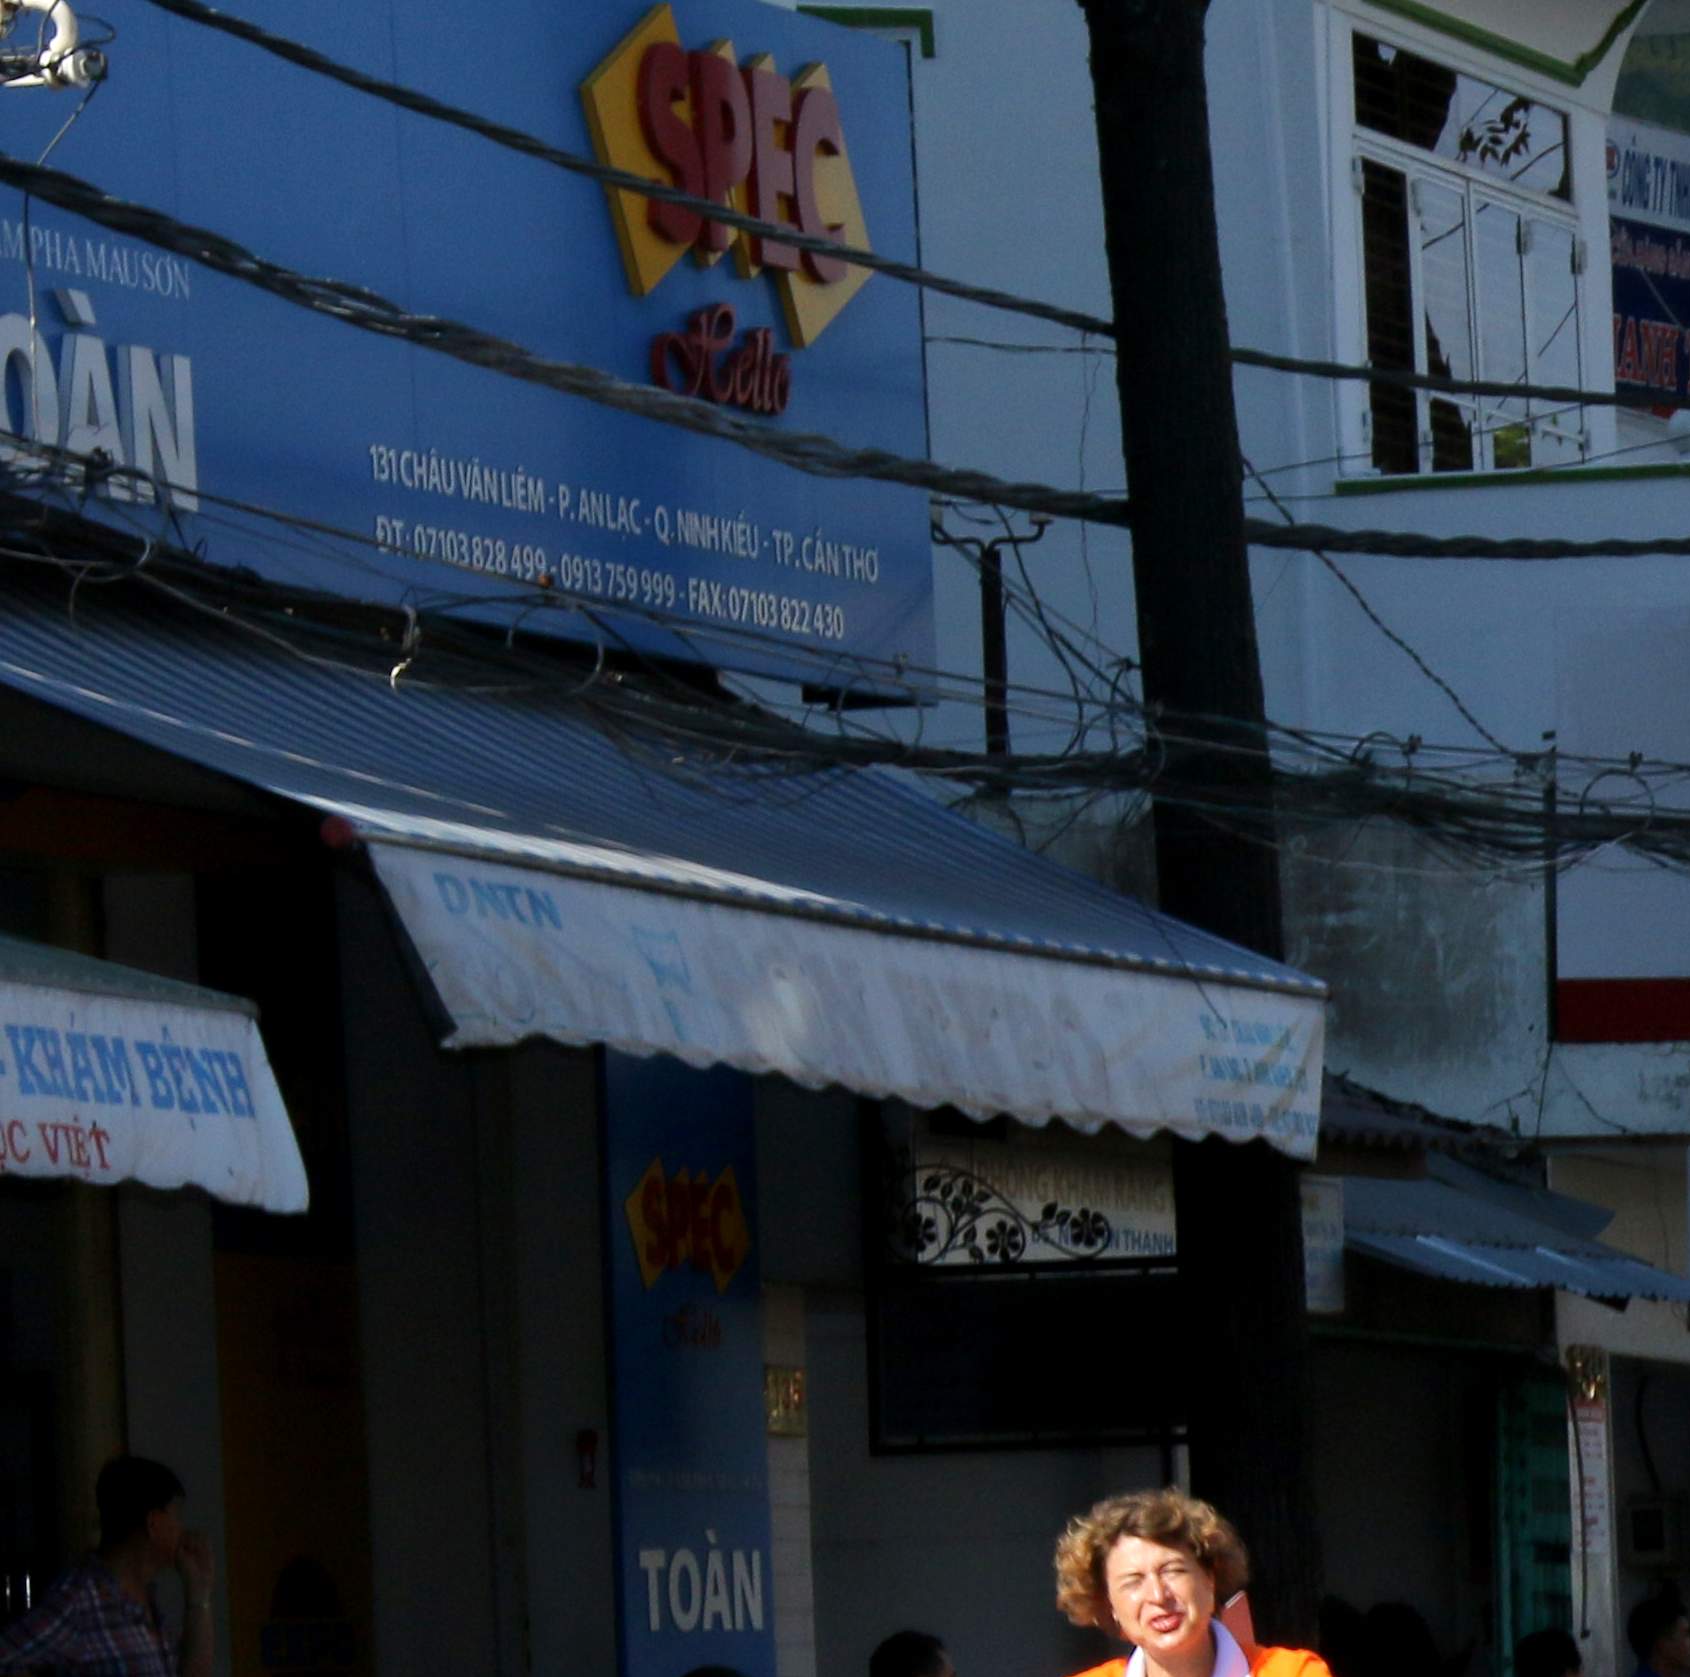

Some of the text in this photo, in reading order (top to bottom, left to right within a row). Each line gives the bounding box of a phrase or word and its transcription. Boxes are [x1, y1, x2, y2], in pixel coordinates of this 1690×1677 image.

[638, 40, 849, 285] SPEC
[30, 224, 82, 276] PHA
[370, 444, 397, 485] 131
[400, 447, 455, 497] CHÂU
[457, 457, 499, 505] VĂN
[579, 489, 604, 528] AN
[605, 494, 642, 542] LẠC
[676, 508, 720, 550] NINH
[842, 547, 880, 583] THƠ
[413, 523, 470, 567] 07103
[472, 535, 507, 575] 828
[511, 544, 547, 580] 499
[560, 553, 603, 594] 0913
[605, 562, 638, 600] 759
[641, 569, 675, 608] 999
[728, 586, 778, 627] 07103
[781, 597, 811, 634] 822
[813, 604, 844, 640] 430
[433, 872, 563, 932] DNTN
[4, 1011, 257, 1132] KHÁM BỆNH
[0, 1119, 31, 1169] C
[641, 1175, 737, 1273] SPEC
[637, 1528, 764, 1633] TOÀN
